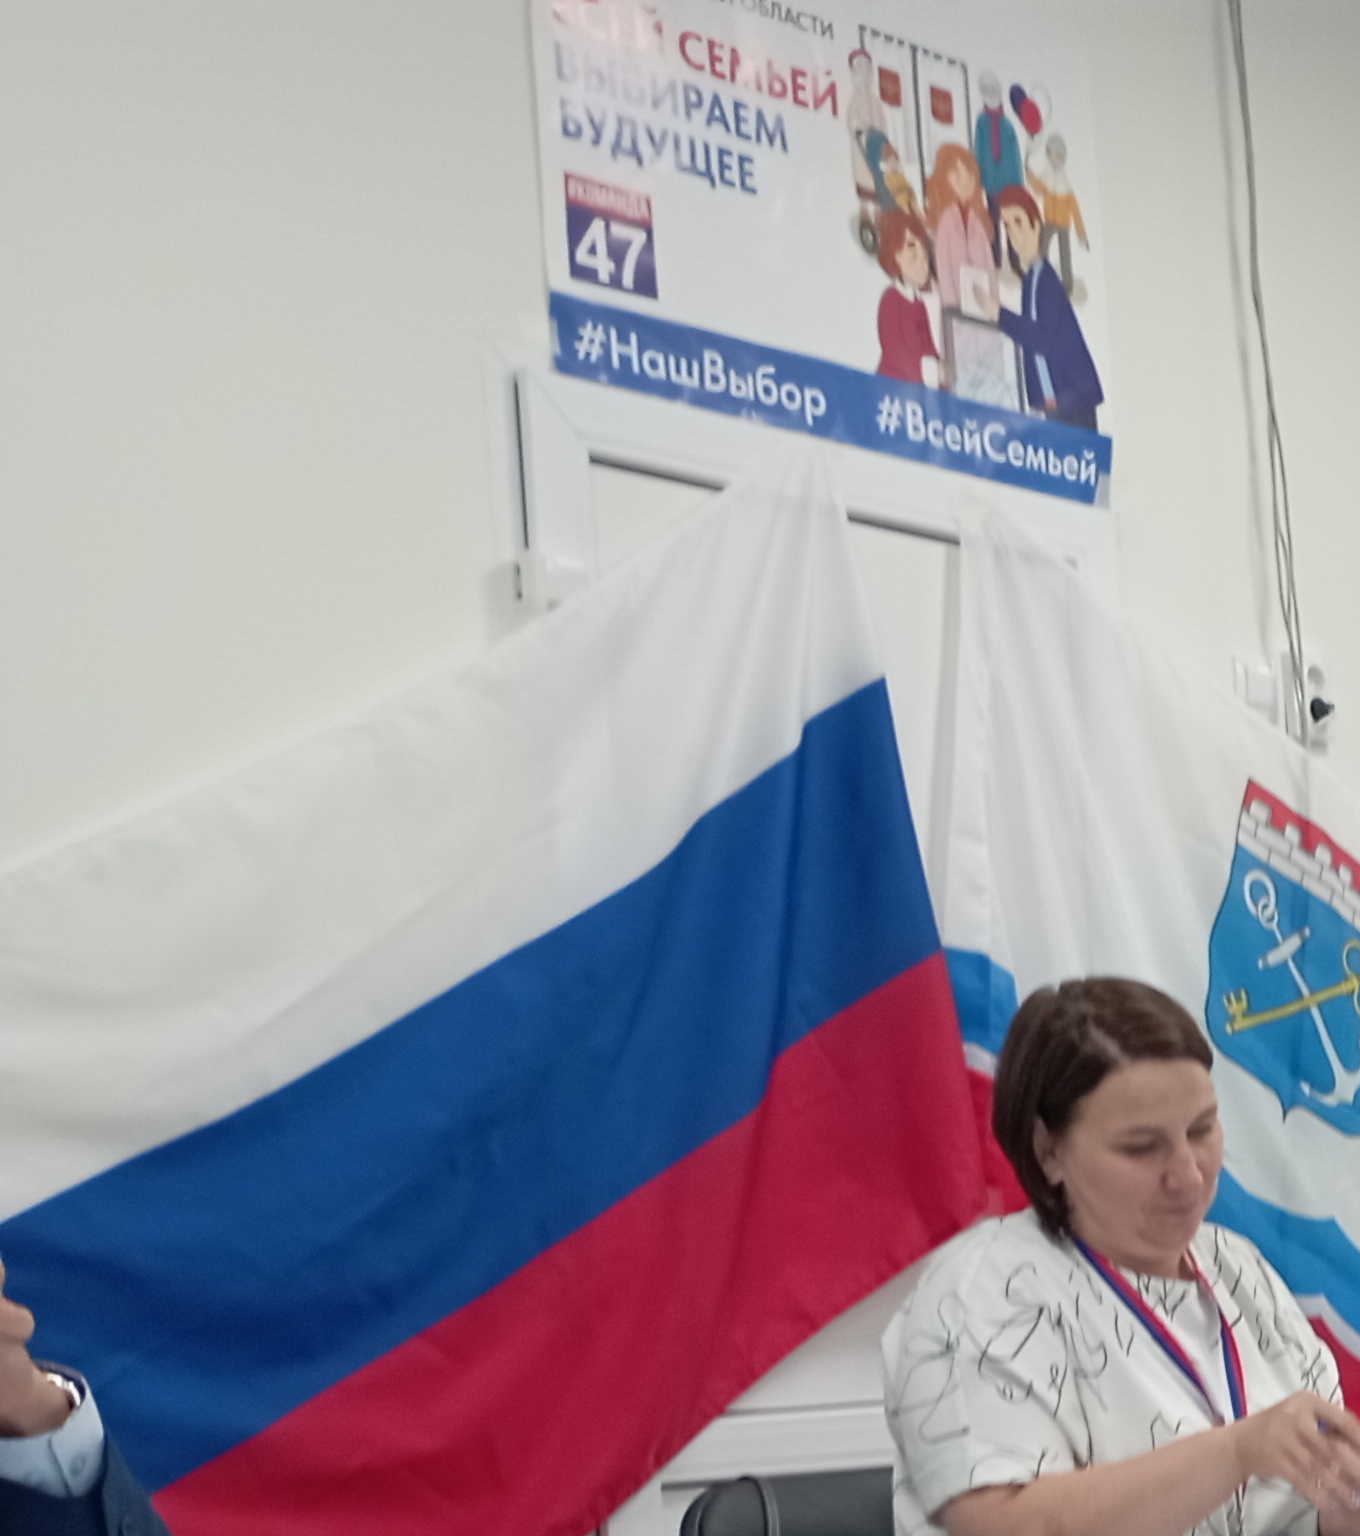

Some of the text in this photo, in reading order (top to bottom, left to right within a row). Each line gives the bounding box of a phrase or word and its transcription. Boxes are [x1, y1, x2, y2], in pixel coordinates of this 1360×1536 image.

[560, 97, 757, 194] БУДУЩЕЕ
[575, 215, 648, 291] 47
[574, 319, 827, 427] #НашВыбор
[876, 393, 1098, 487] #ВсейСемьей
